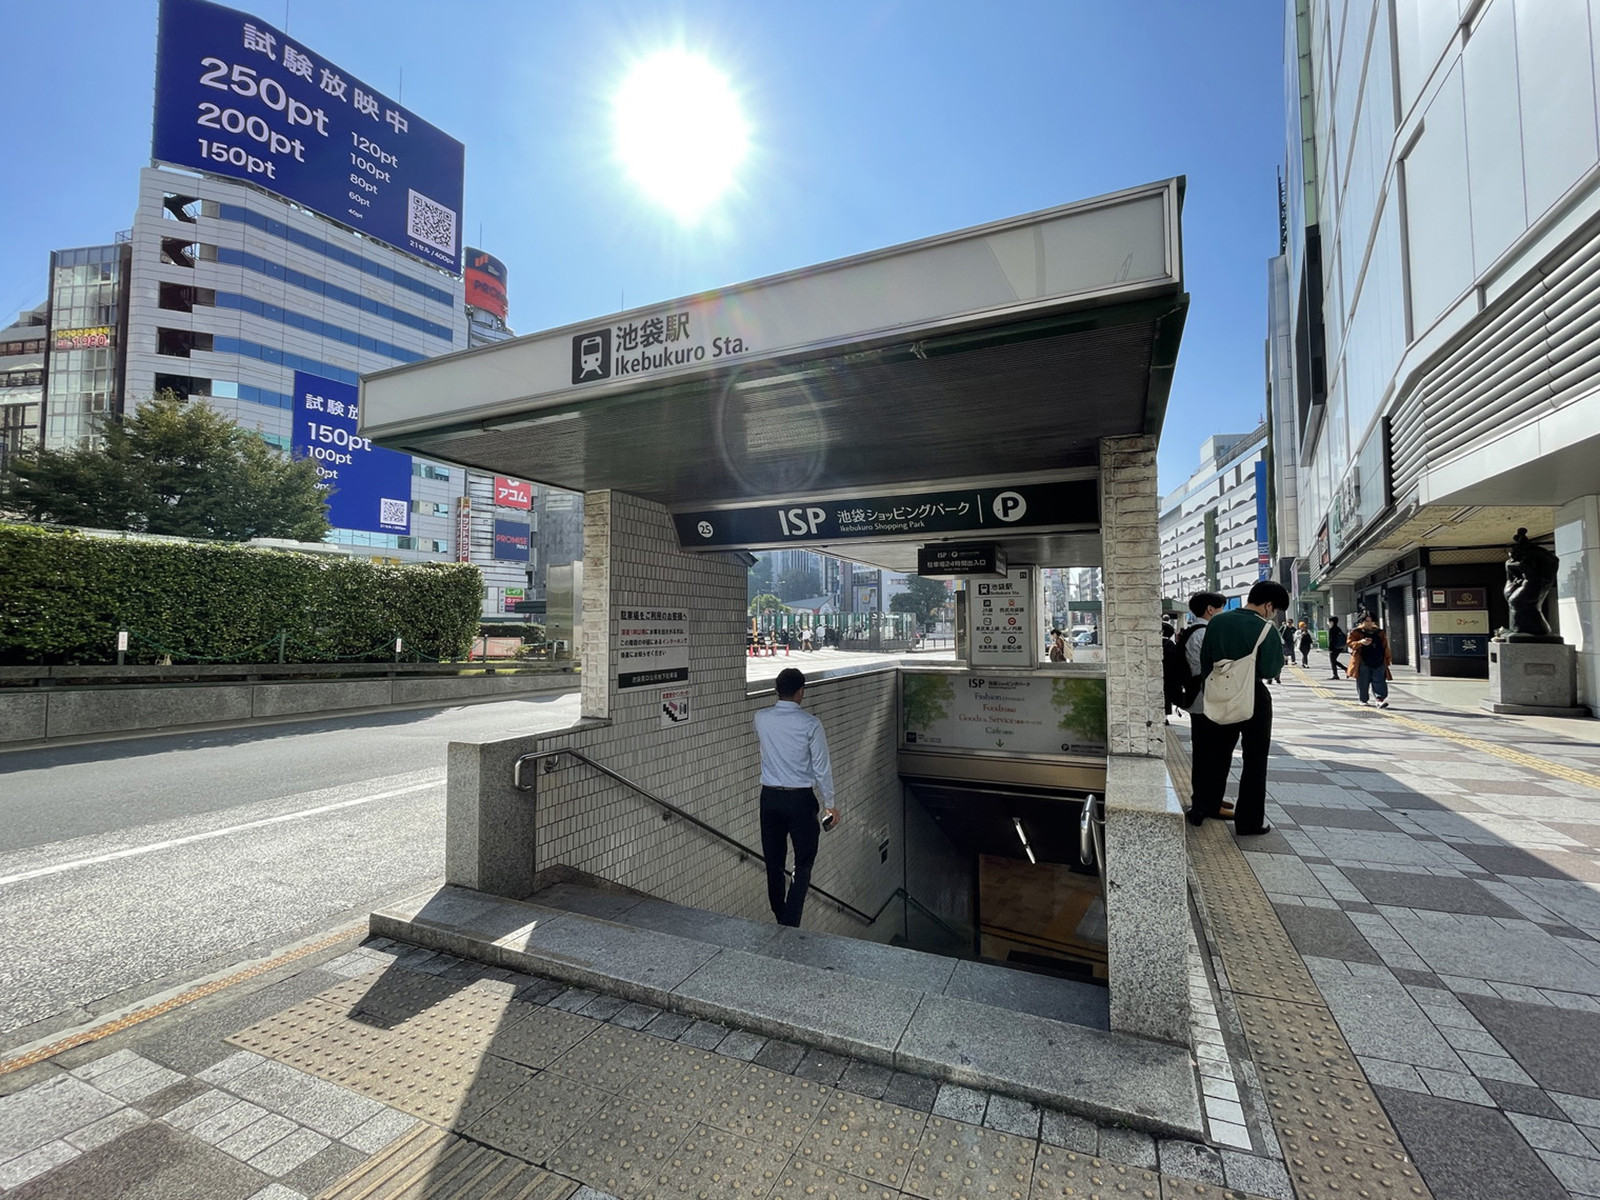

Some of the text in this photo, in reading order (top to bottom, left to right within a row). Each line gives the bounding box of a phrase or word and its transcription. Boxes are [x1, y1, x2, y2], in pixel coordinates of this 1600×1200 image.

[243, 23, 409, 134] 試験放映中
[199, 57, 330, 138] 250pt
[197, 102, 305, 162] 200pt
[198, 138, 276, 180] 150pt
[351, 131, 399, 169] 120pt
[350, 152, 391, 184] 100pt
[348, 191, 371, 207] 60pt
[350, 173, 378, 195] 80pt
[615, 311, 690, 353] 池袋駅
[615, 337, 749, 376] Ikebukuro Sta.
[307, 422, 372, 452] 150pt
[307, 445, 352, 465] 100pt
[316, 466, 338, 479] 0pt
[498, 487, 528, 502] アコム
[778, 507, 826, 536] ISP
[837, 501, 970, 524] 池袋ショッピングパーク
[840, 519, 925, 532] Ikebukuro Shopping Park
[496, 534, 528, 545] PROMISE
[1259, 542, 1270, 576] SEIBU
[968, 678, 985, 688] ISP
[974, 692, 1002, 701] Fashion
